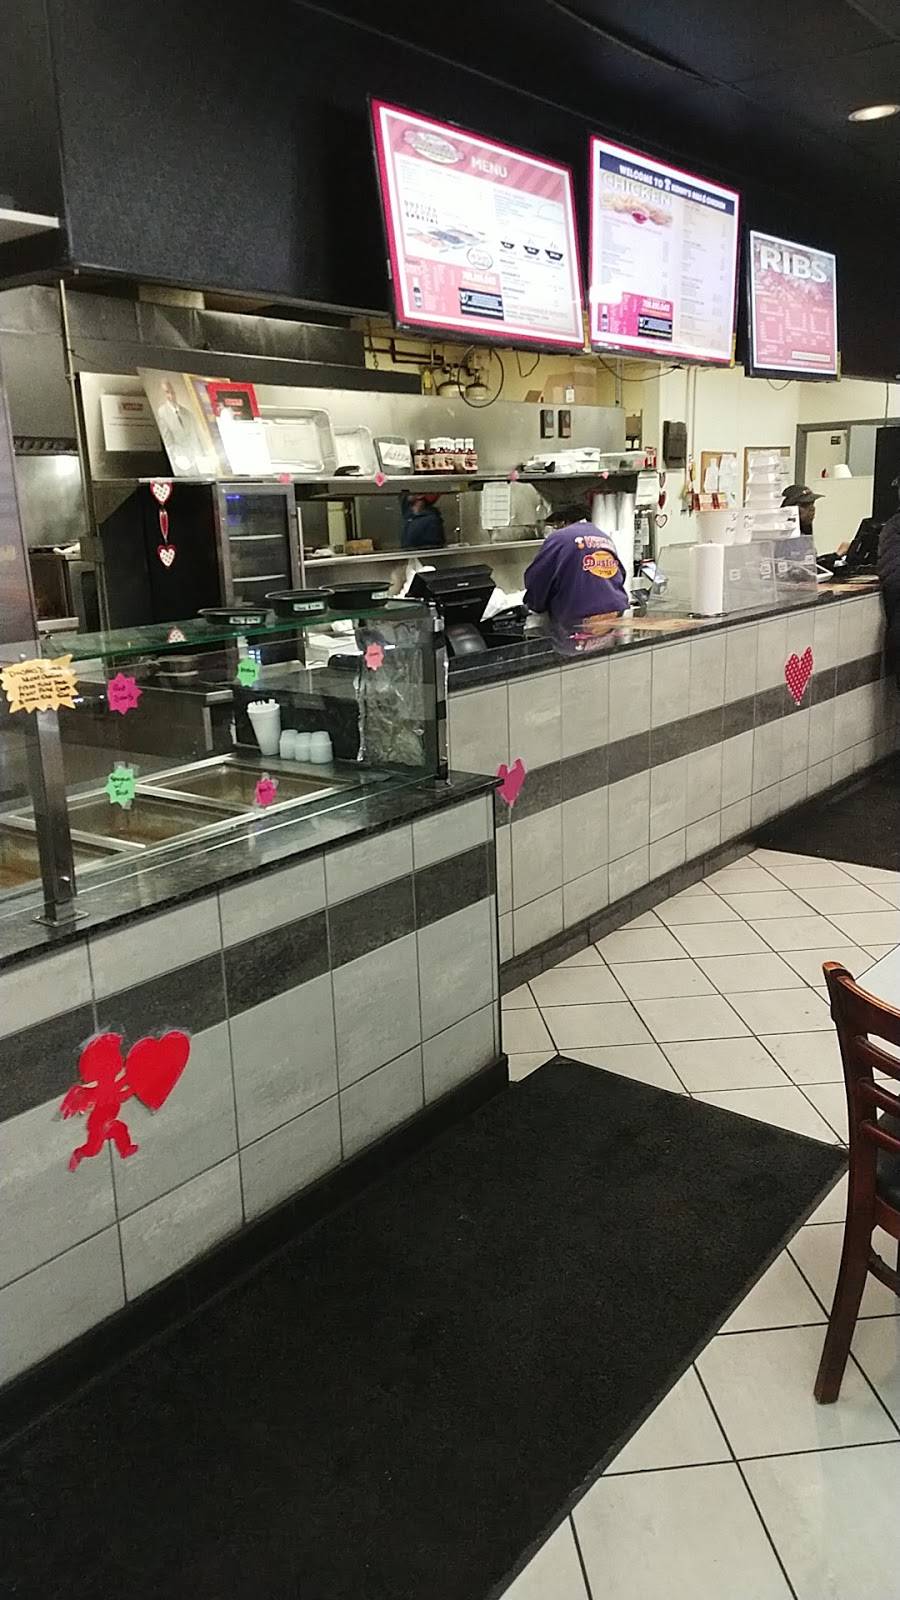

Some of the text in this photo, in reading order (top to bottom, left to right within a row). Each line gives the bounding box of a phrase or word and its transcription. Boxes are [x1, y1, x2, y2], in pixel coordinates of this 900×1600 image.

[471, 156, 508, 178] MENU
[619, 164, 653, 186] WELCOME
[654, 175, 663, 189] TO
[603, 173, 672, 206] CHICKEN
[760, 246, 827, 283] RIBS
